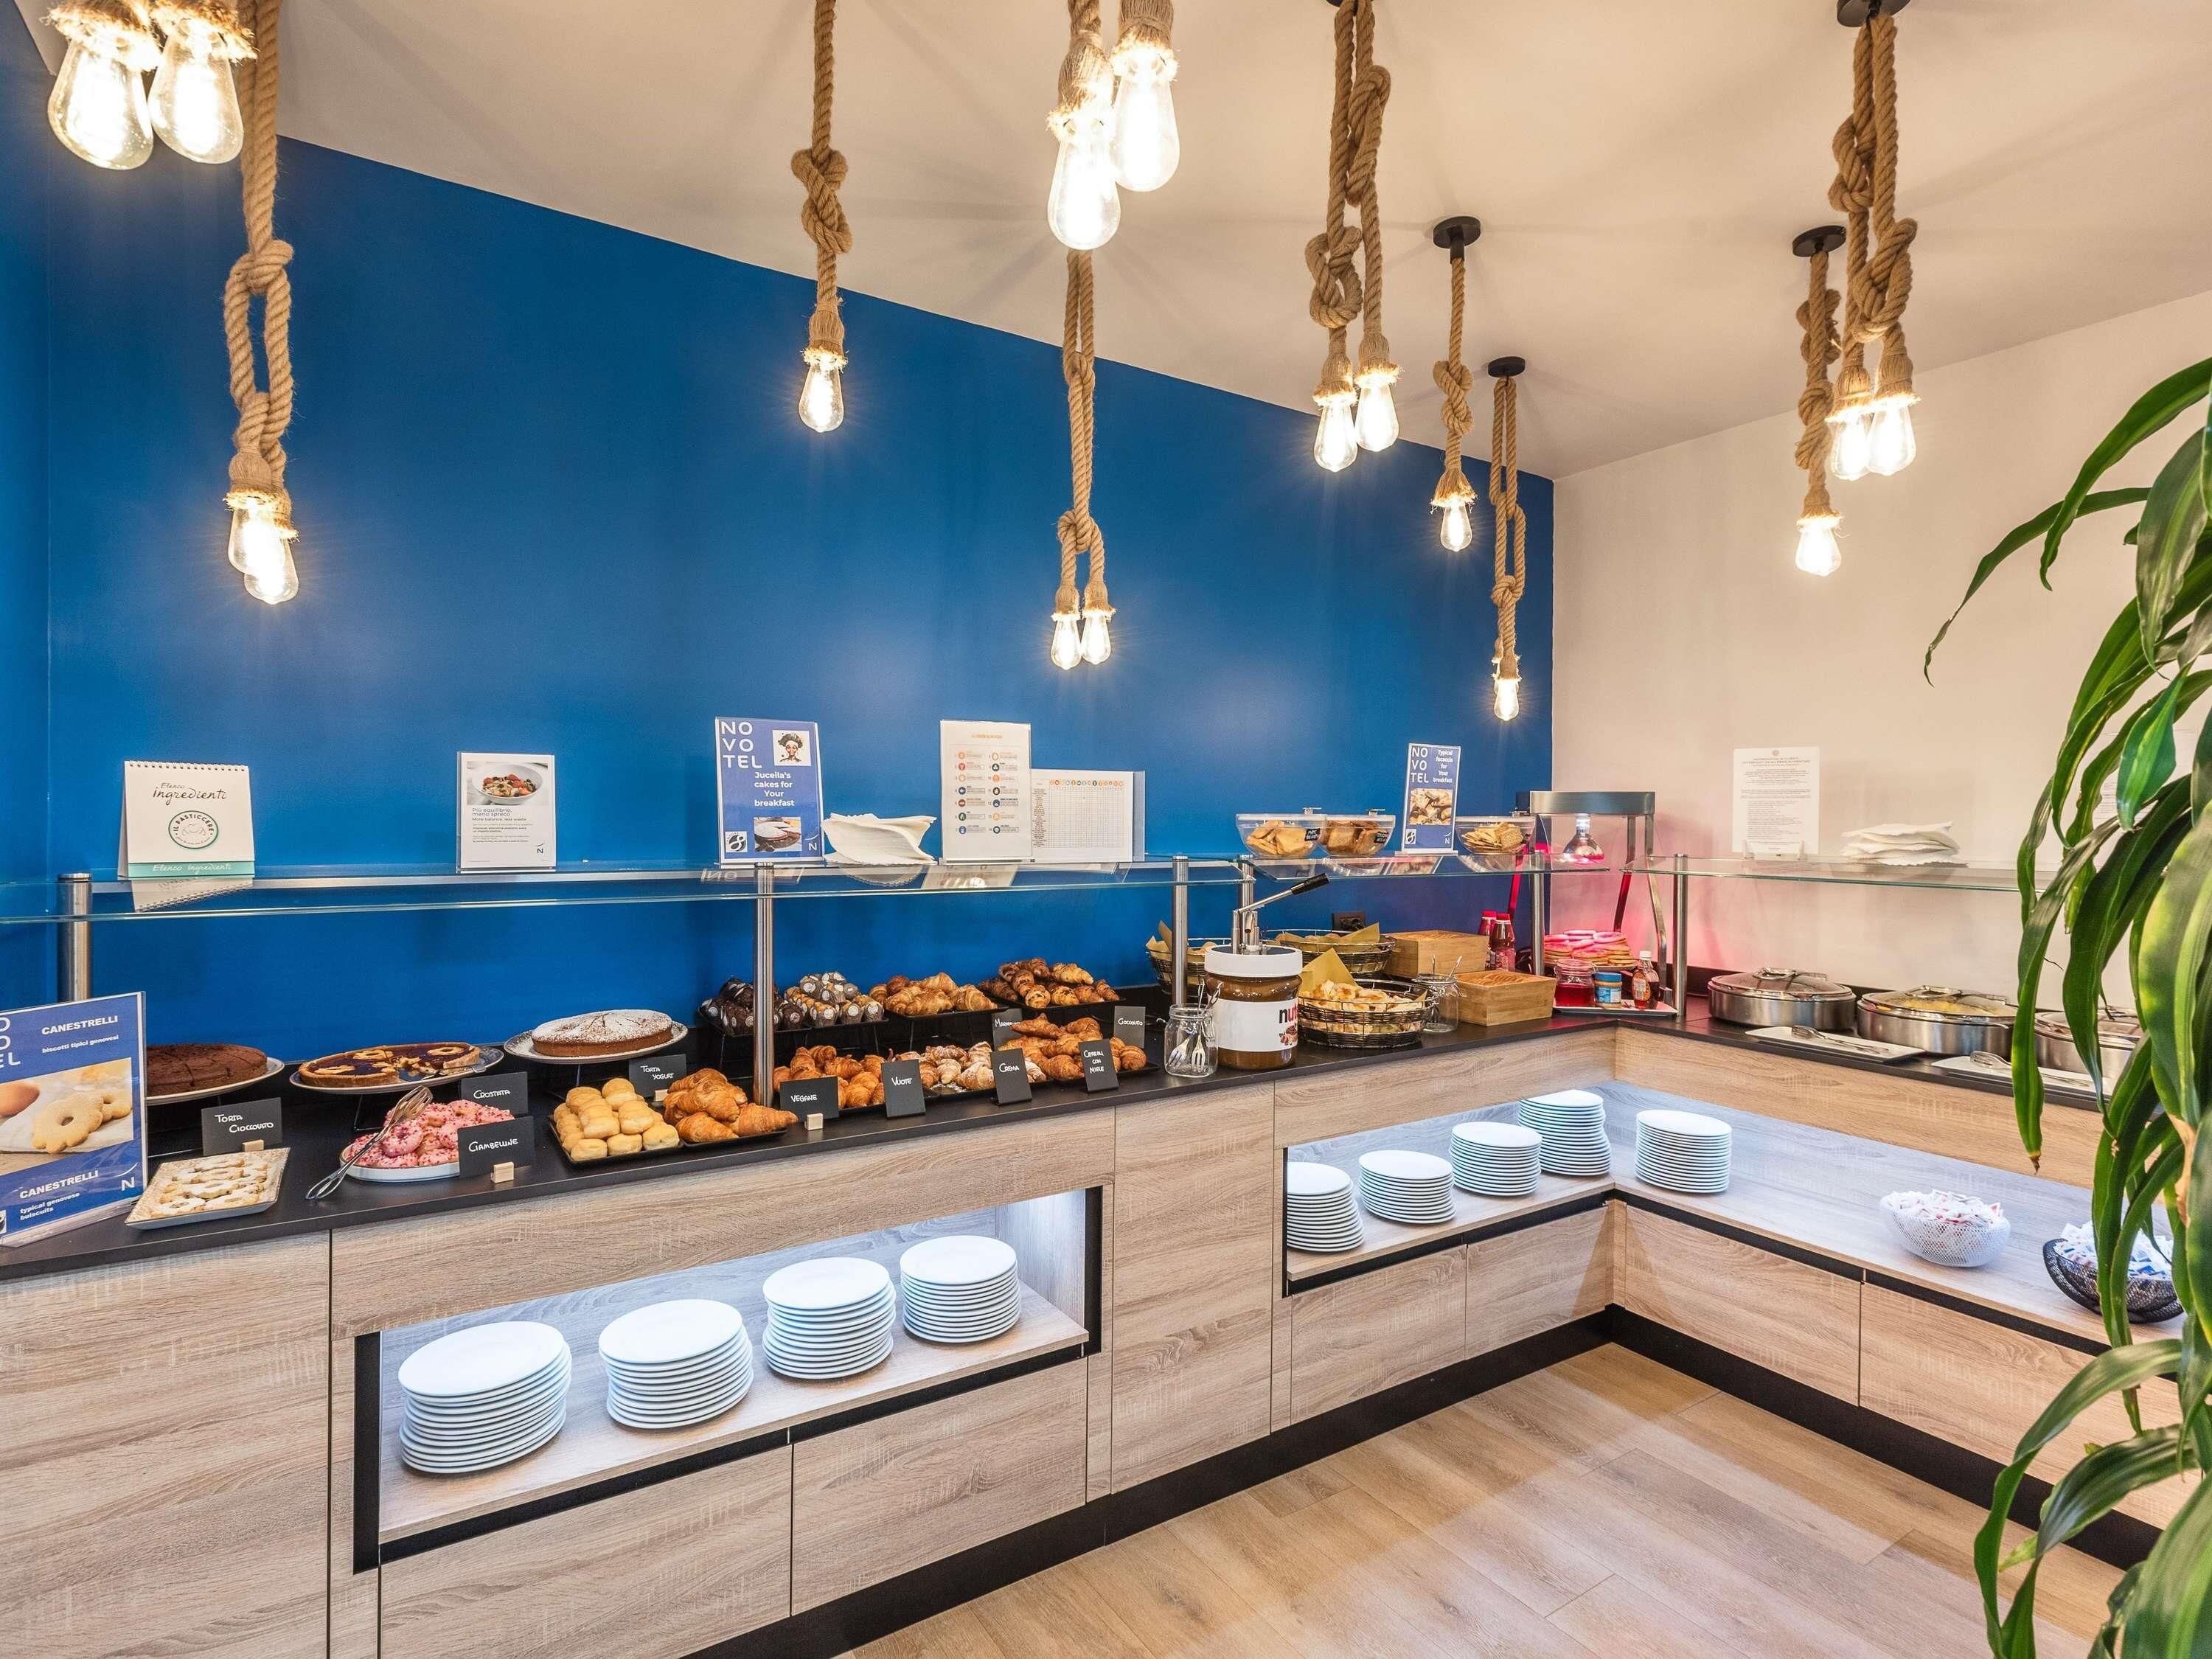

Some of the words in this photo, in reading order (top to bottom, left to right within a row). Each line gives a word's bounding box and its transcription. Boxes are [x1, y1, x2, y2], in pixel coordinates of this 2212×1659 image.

[720, 721, 753, 735] NO
[723, 738, 754, 752] VO
[1412, 747, 1428, 758] NO
[723, 754, 762, 768] TEL
[1411, 760, 1427, 771] VO
[1411, 773, 1429, 783] TEL
[152, 786, 228, 806] ingredienti
[175, 813, 214, 832] PASTICCERE
[808, 842, 818, 851] N
[152, 863, 183, 872] Elenco
[41, 1015, 119, 1035] CANESTRELLI
[42, 1043, 69, 1054] biscotti
[71, 1039, 88, 1049] tipici
[89, 1034, 119, 1046] genovesi
[640, 1065, 661, 1073] TORTA
[652, 1072, 675, 1080] YOGURT
[891, 1077, 913, 1086] VUOTE
[473, 1089, 511, 1099] CROSTATA
[790, 1094, 818, 1103] VEGANE
[214, 1113, 243, 1123] TORTA
[229, 1121, 274, 1133] CIOCCOLATO
[468, 1138, 519, 1152] CIAMBELLINE
[19, 1170, 99, 1199] CANESTRELLI
[121, 1176, 136, 1192] N
[20, 1201, 46, 1214] typical
